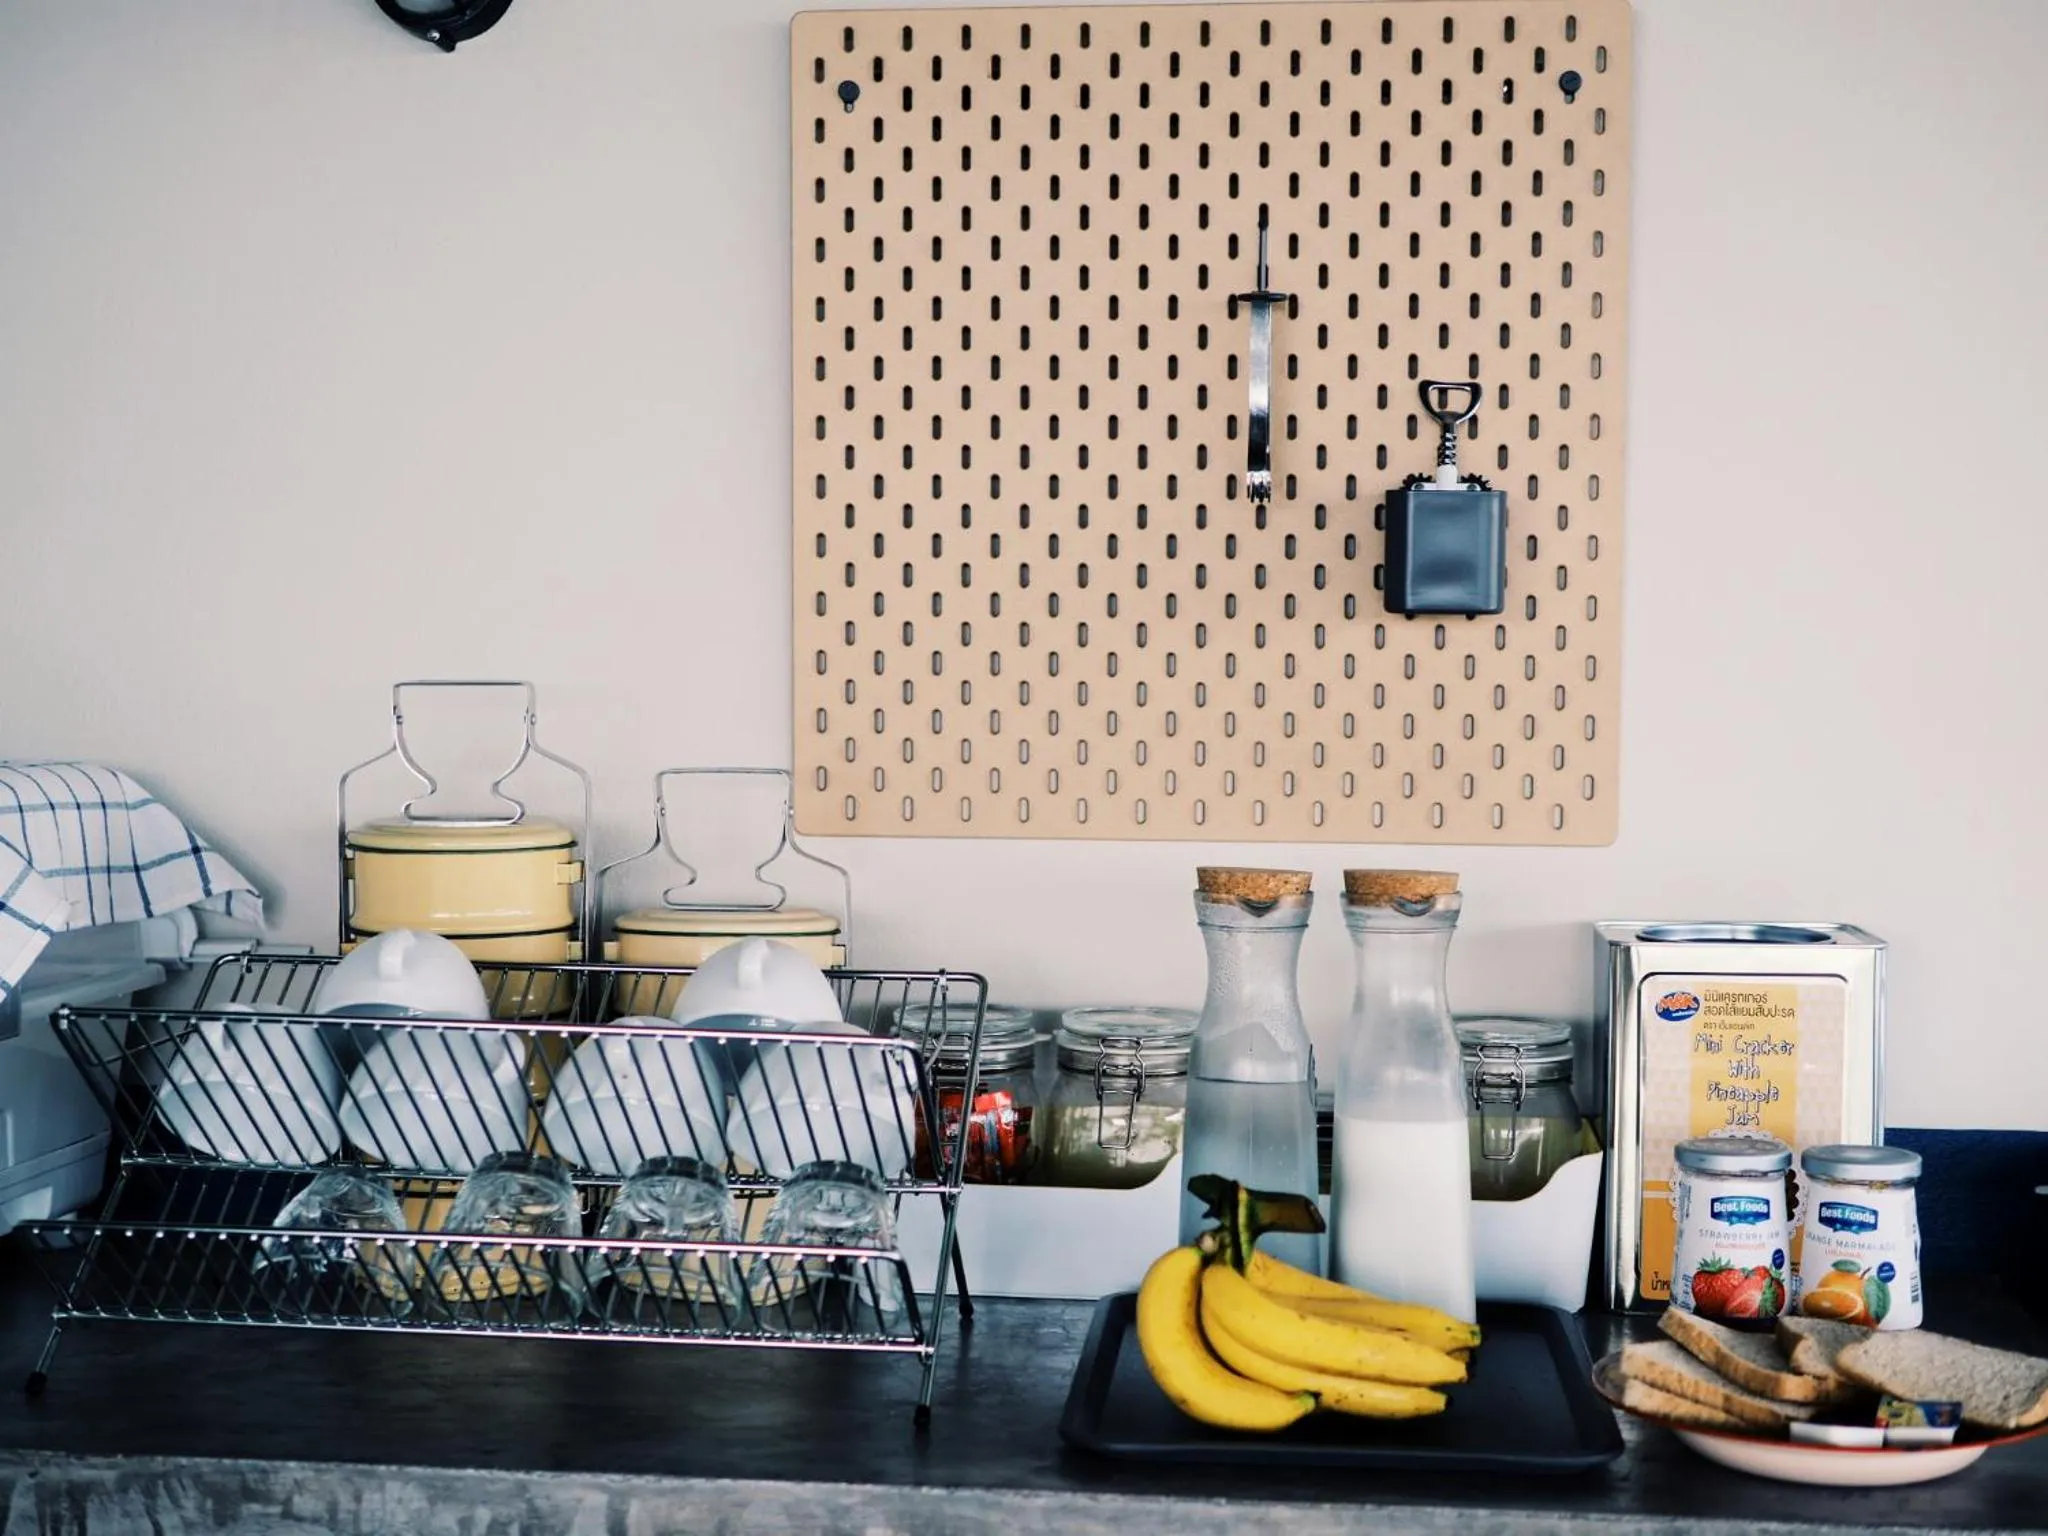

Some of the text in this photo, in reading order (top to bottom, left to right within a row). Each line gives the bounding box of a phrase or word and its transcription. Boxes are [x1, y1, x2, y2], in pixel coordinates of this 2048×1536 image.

[1694, 1033, 1795, 1056] Mini Cracker
[1707, 1080, 1779, 1112] Pineapple
[1725, 1106, 1760, 1126] Jam
[1713, 1201, 1769, 1214] Best Foods
[1820, 1207, 1877, 1224] Best Foods
[1698, 1228, 1763, 1241] STRAWBERRY
[1804, 1232, 1832, 1246] RANGE
